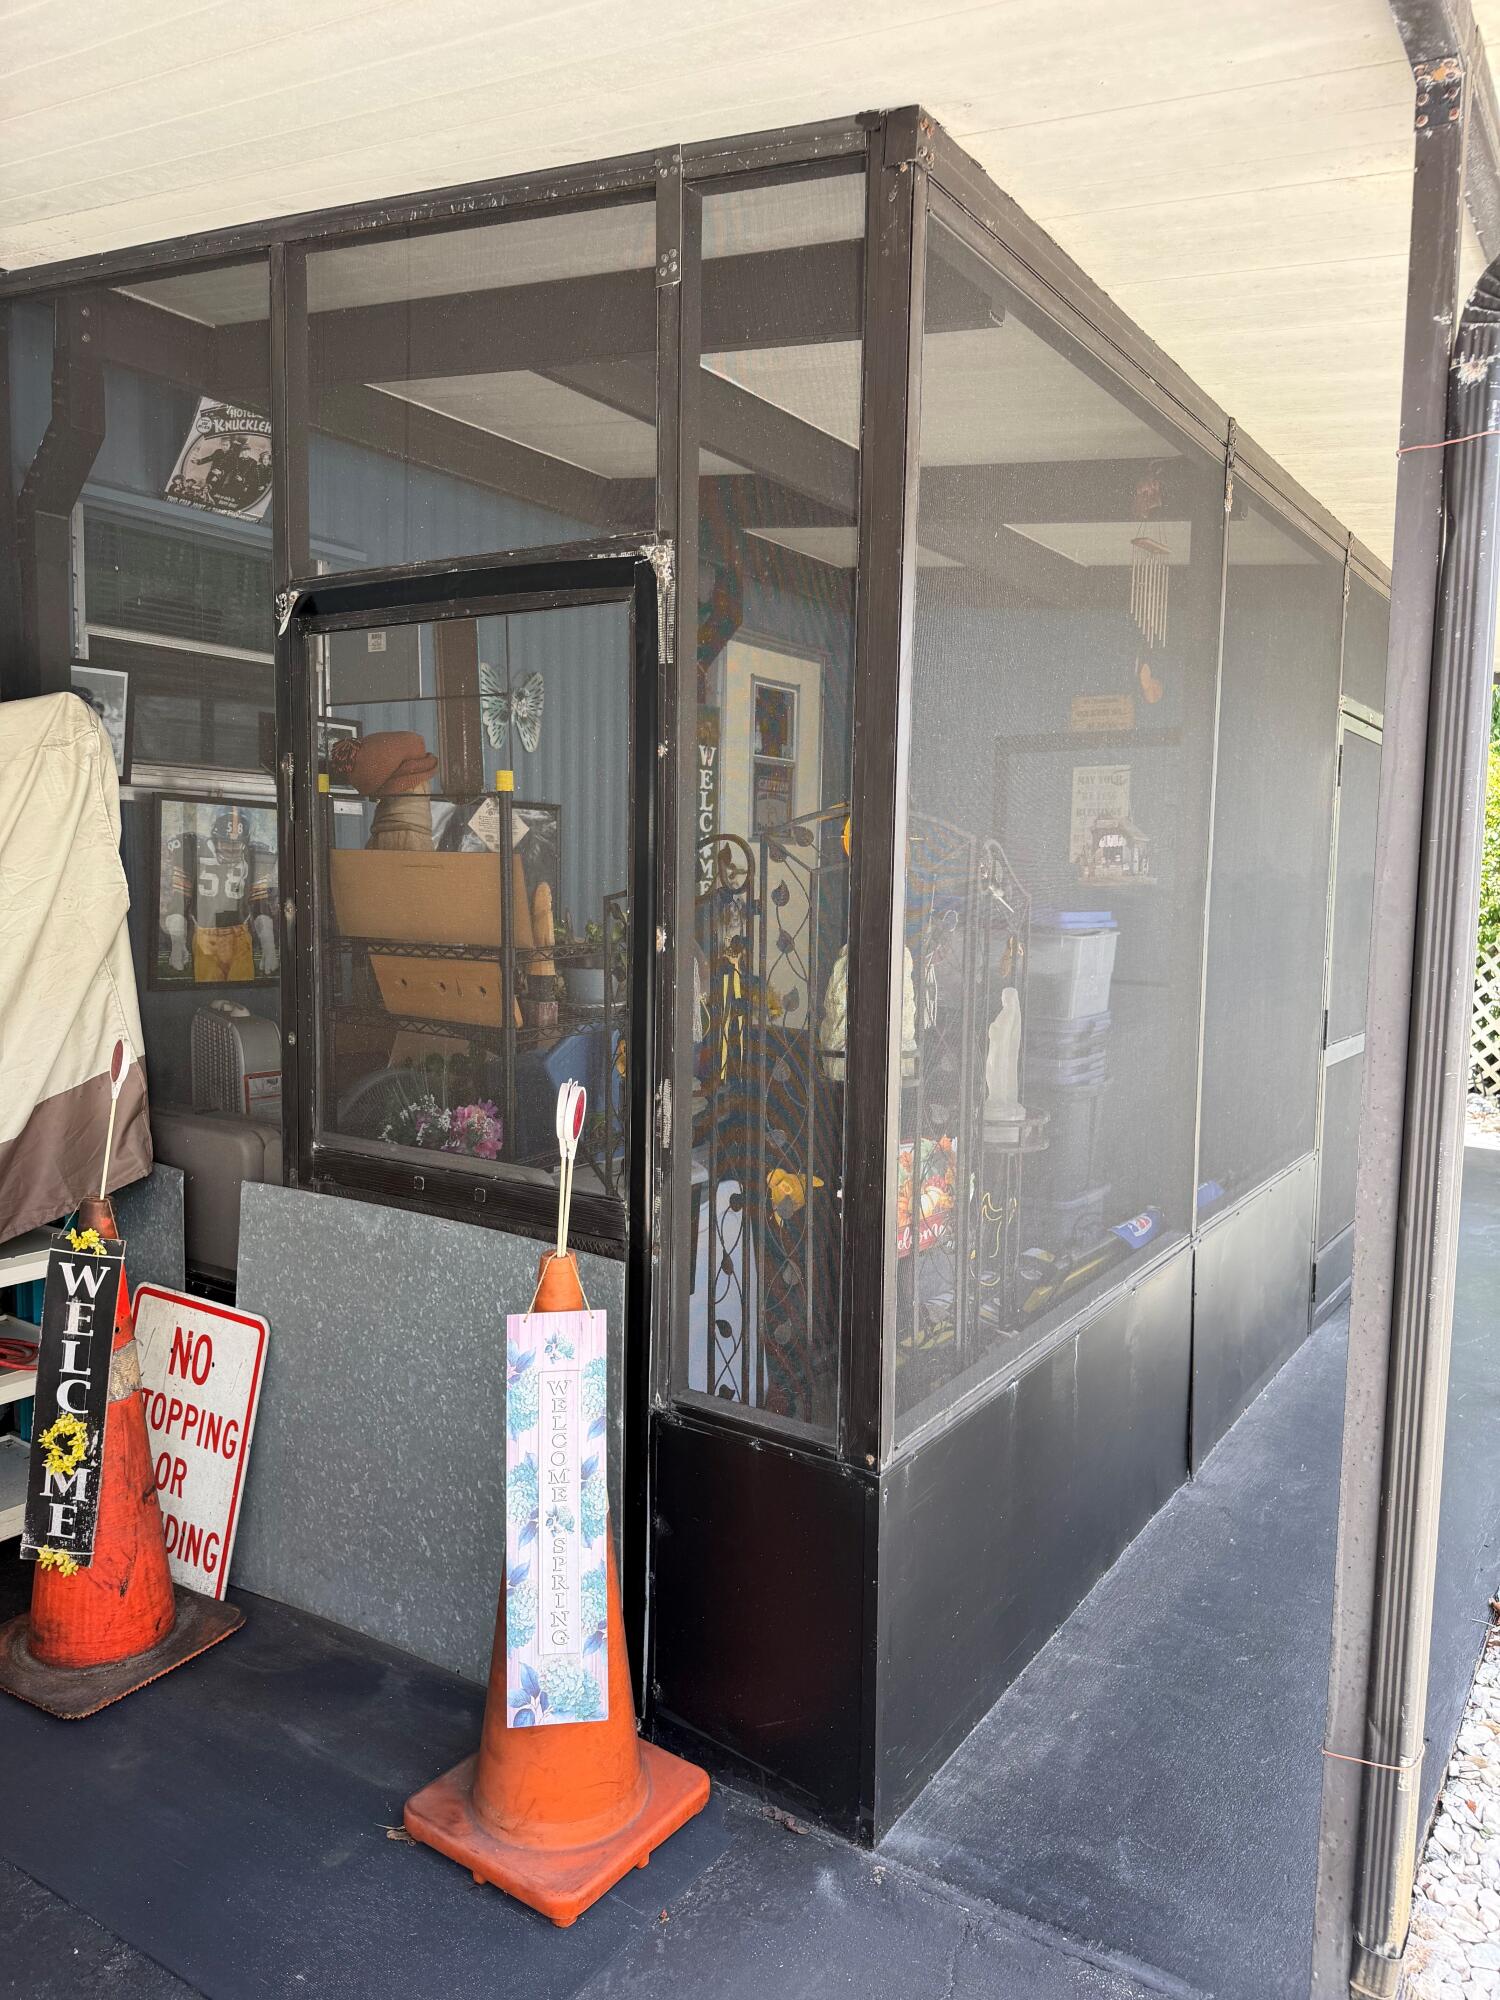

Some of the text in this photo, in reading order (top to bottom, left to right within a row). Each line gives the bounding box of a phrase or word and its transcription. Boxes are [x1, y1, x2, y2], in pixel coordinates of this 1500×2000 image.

[229, 407, 259, 419] HOTEL
[198, 858, 249, 899] 58
[168, 1326, 213, 1386] NO
[141, 1387, 240, 1460] TOPPING
[155, 1451, 188, 1499] OR
[160, 1511, 220, 1574] DING
[547, 1380, 570, 1646] WELCOME SPRING
